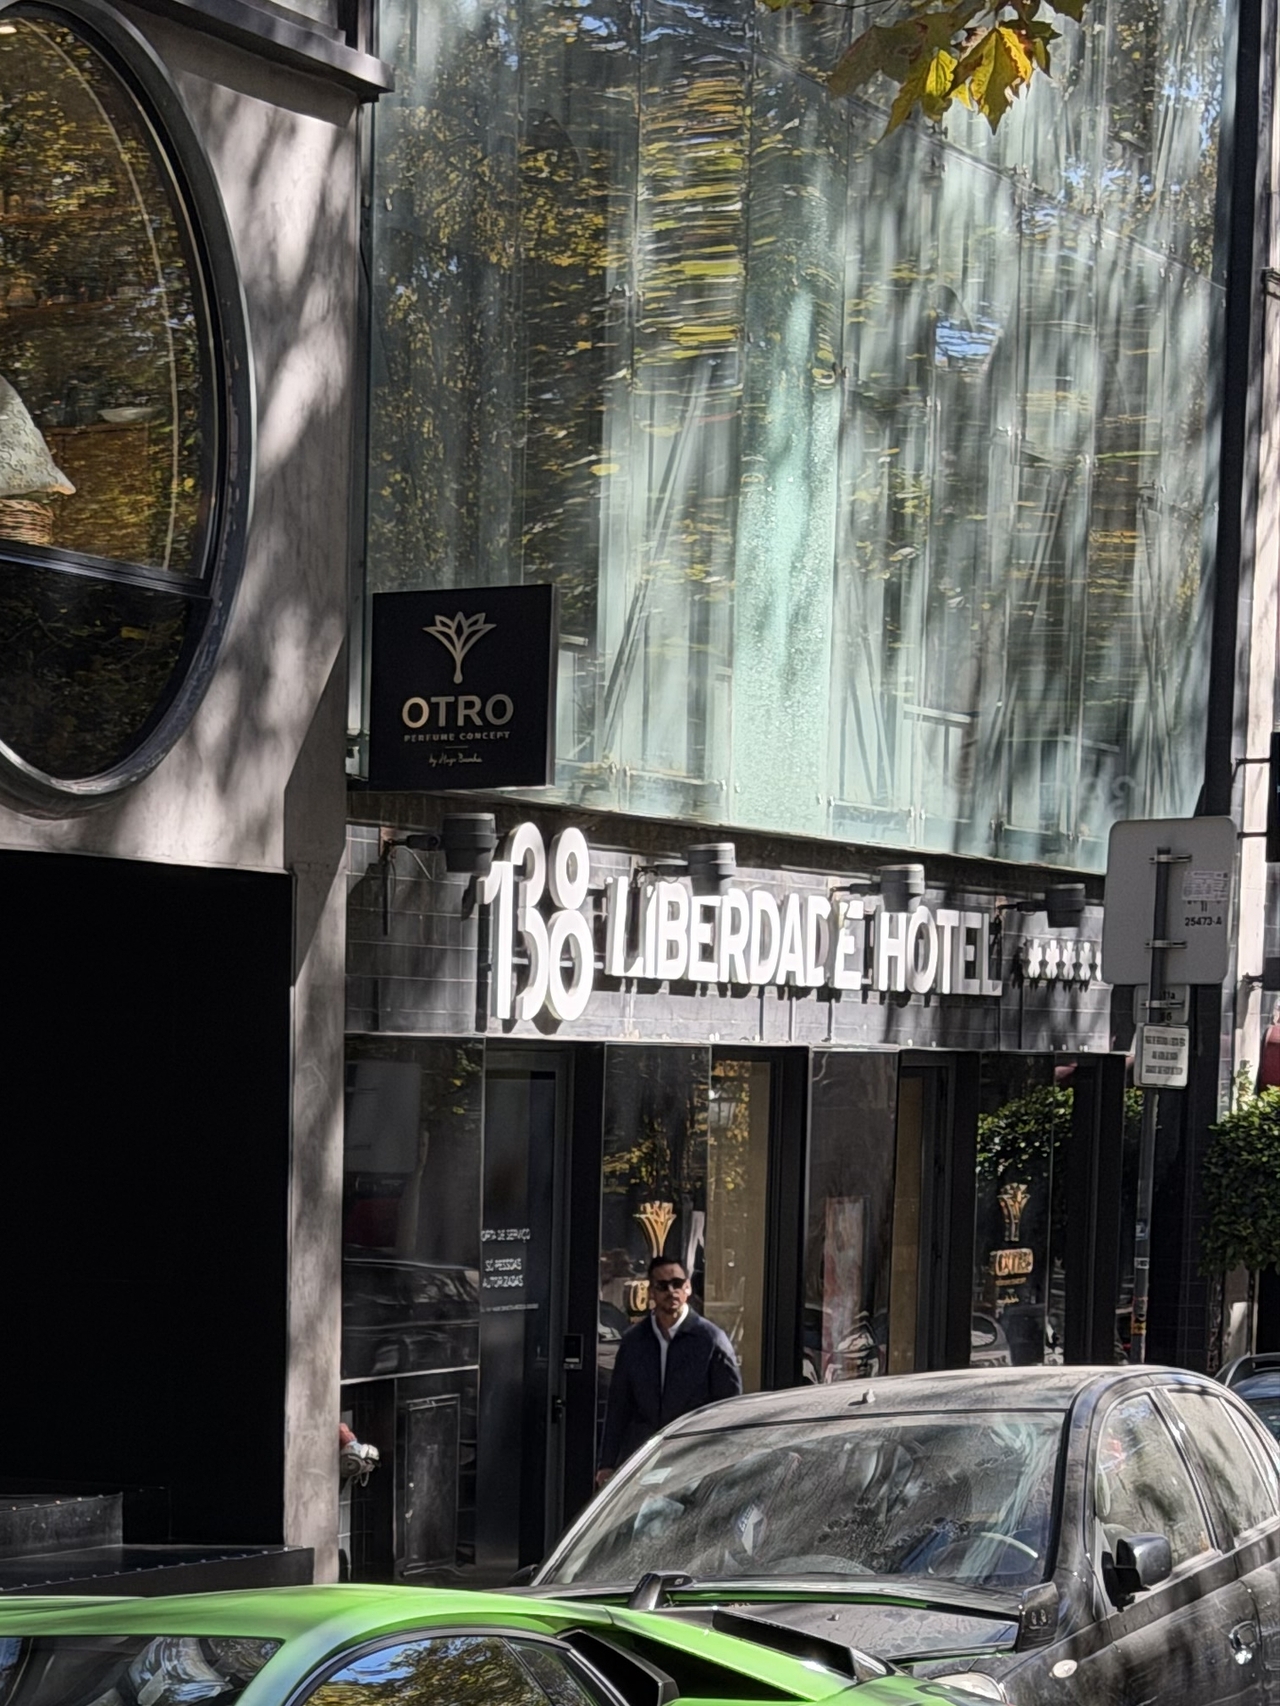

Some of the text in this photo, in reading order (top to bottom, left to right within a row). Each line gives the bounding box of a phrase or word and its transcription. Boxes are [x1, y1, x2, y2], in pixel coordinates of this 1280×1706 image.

[402, 694, 513, 728] OTRO
[405, 732, 510, 742] PERFUME CONCEPT
[478, 821, 1003, 1021] 138 LIBERDADE HOTEL
